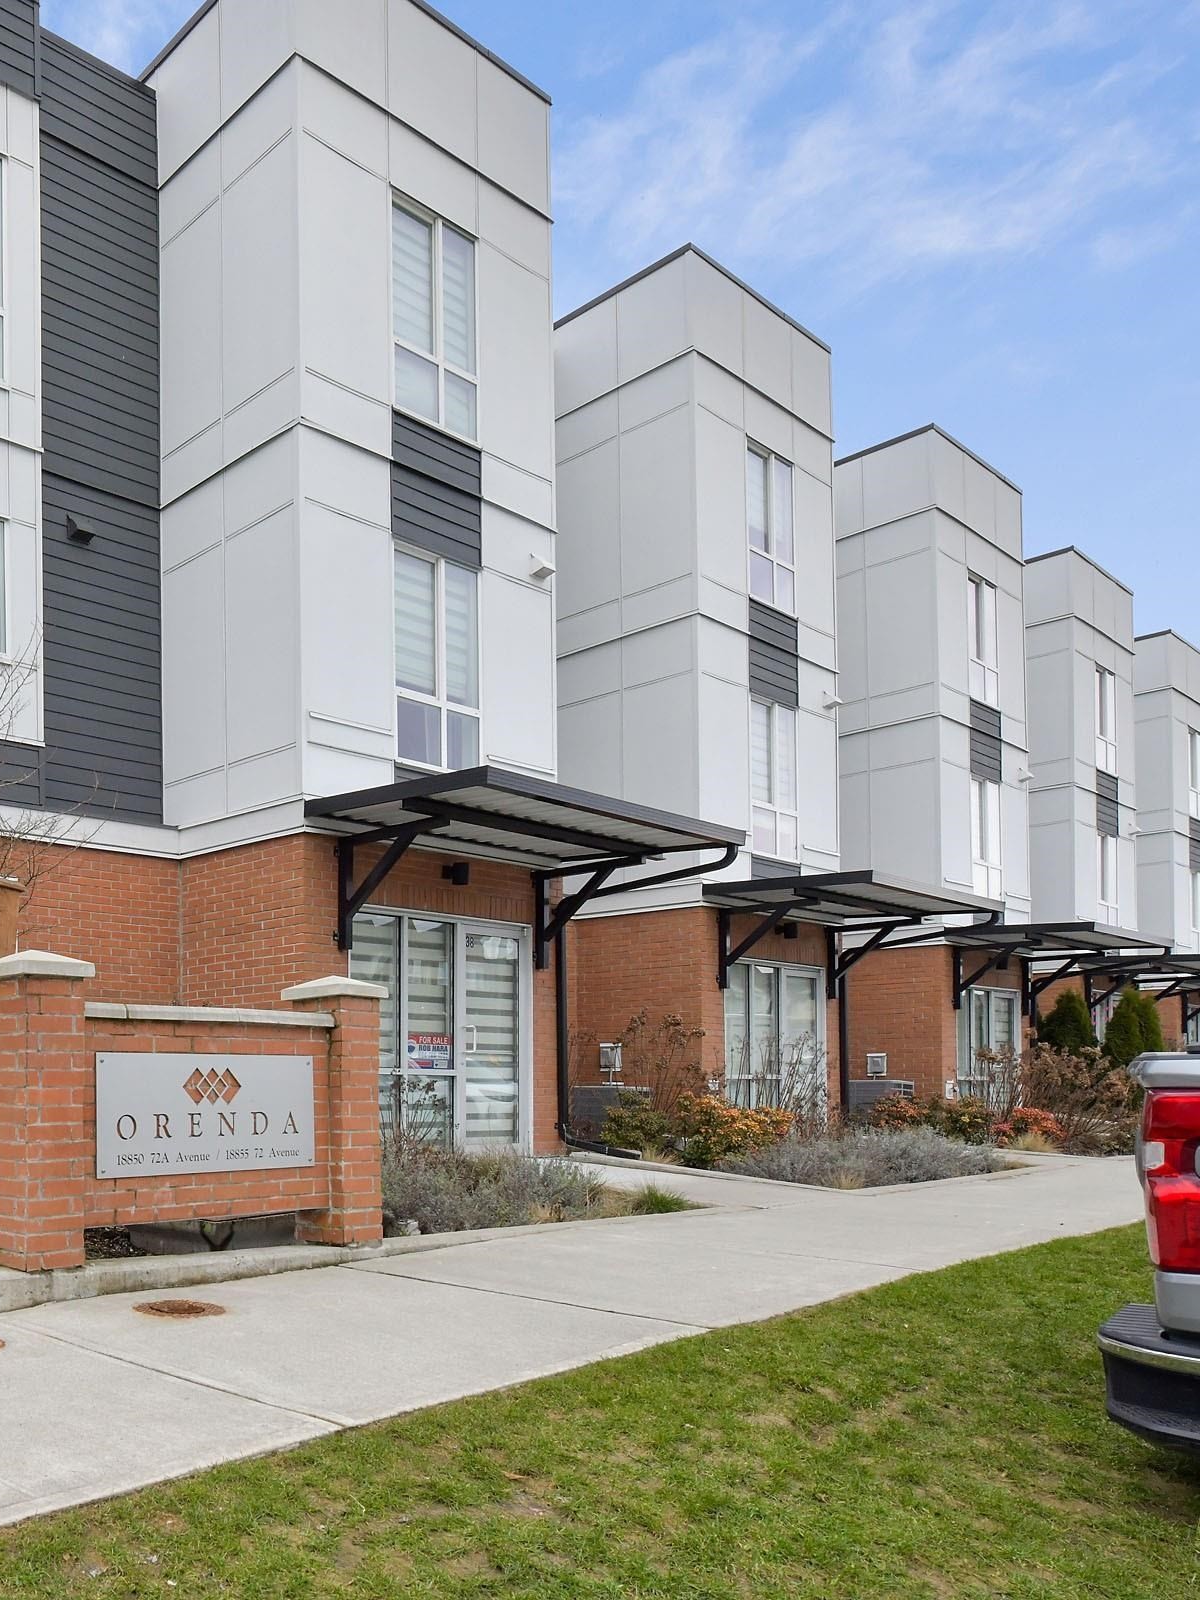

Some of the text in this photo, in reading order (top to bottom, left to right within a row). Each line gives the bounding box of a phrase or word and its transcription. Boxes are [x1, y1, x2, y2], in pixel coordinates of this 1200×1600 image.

[465, 935, 474, 948] 38
[418, 1036, 448, 1045] FOR SALE
[116, 1111, 299, 1140] ORENDA
[117, 1153, 145, 1166] 18850
[150, 1153, 169, 1164] 72A
[176, 1151, 210, 1163] Avenue
[225, 1149, 249, 1160] 18855
[254, 1148, 264, 1159] 72
[269, 1147, 300, 1158] Avenue
